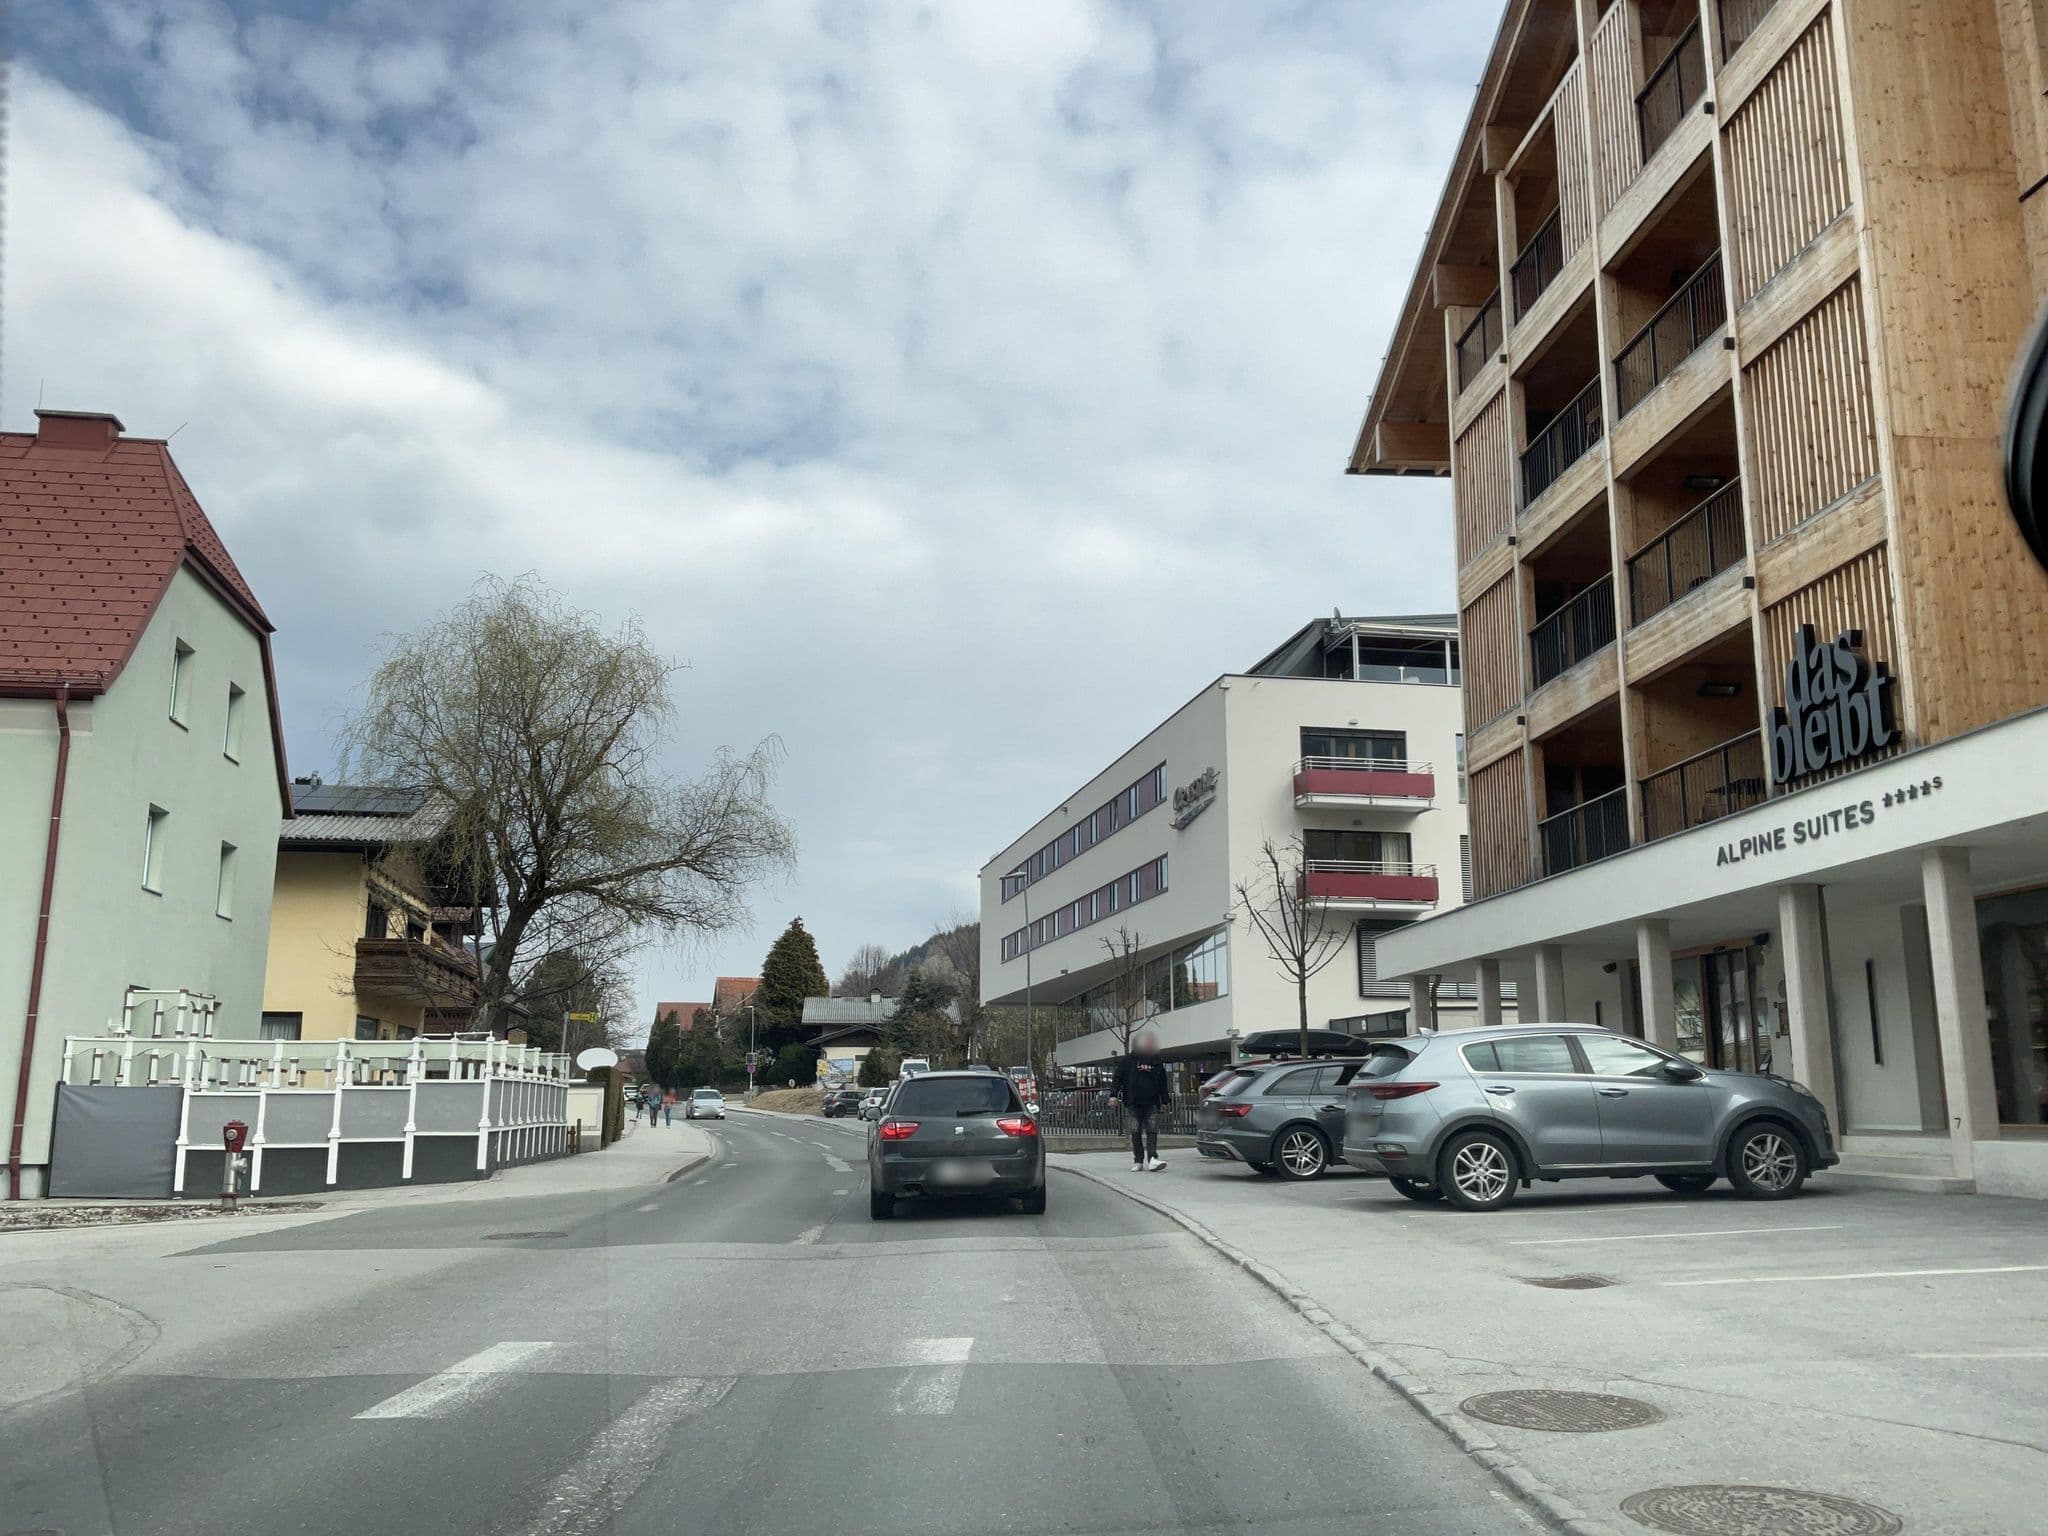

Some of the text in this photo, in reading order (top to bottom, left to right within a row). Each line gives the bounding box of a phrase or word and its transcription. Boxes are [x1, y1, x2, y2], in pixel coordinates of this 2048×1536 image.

[1785, 624, 1865, 712] das
[1766, 661, 1896, 783] bleibt
[1716, 827, 1787, 866] ALPINE
[1792, 800, 1875, 845] SUITES
[1954, 1117, 1961, 1129] 7
